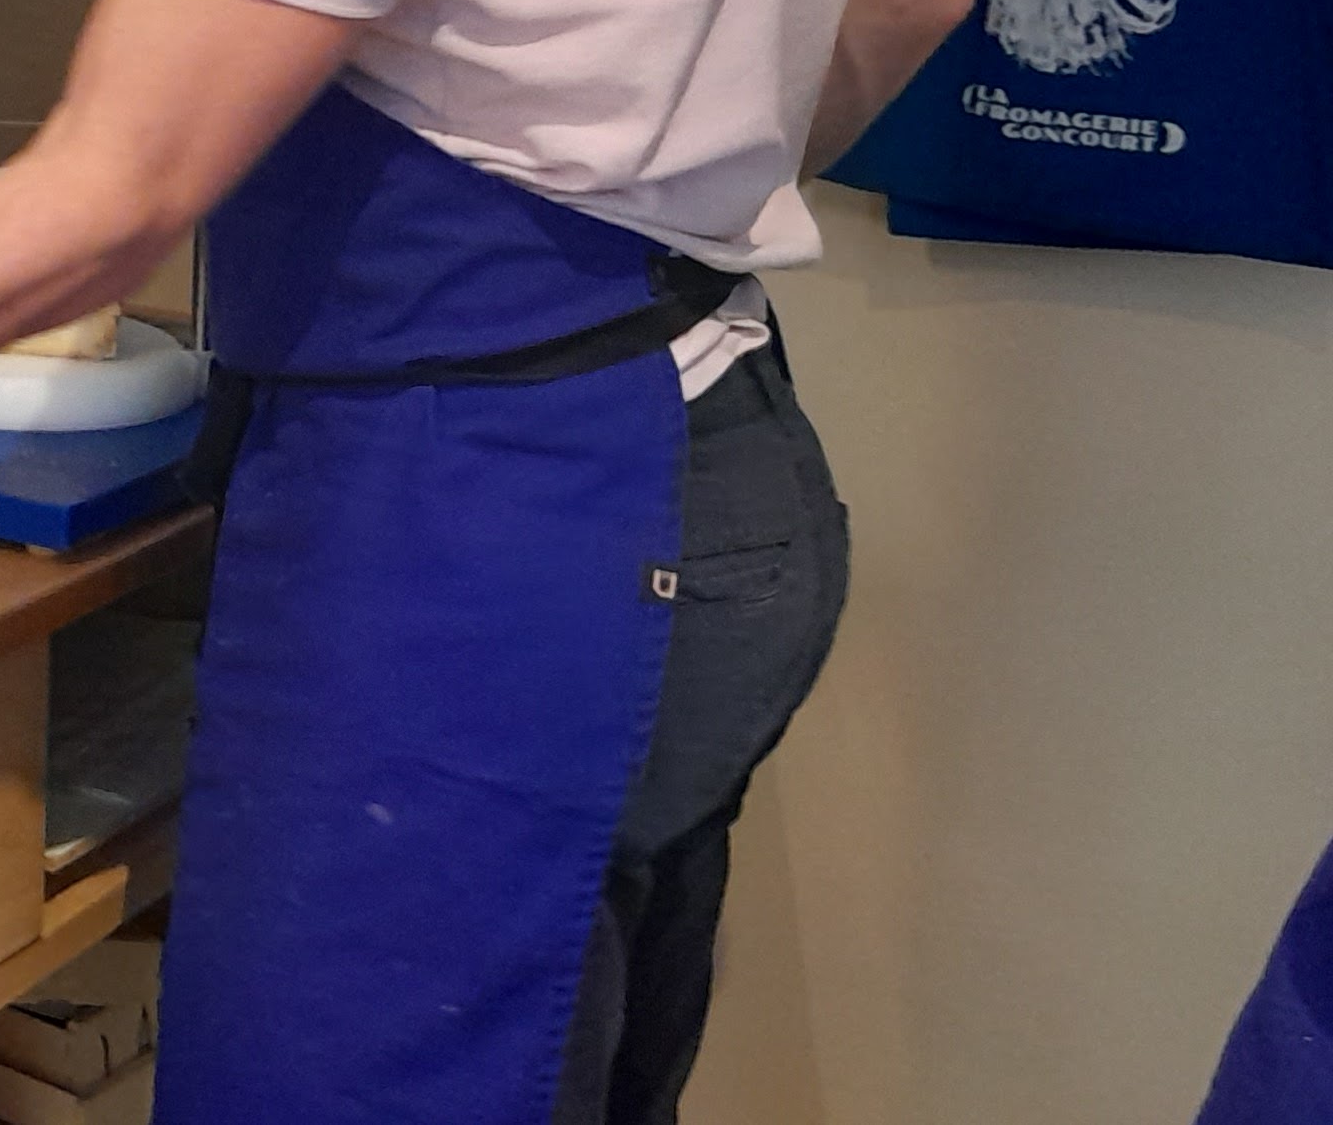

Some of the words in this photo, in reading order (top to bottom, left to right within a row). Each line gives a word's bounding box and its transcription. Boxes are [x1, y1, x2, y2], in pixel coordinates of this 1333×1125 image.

[976, 84, 1010, 105] LA
[974, 100, 1159, 135] FROMAGERIE
[1001, 122, 1158, 152] GONCOURT
